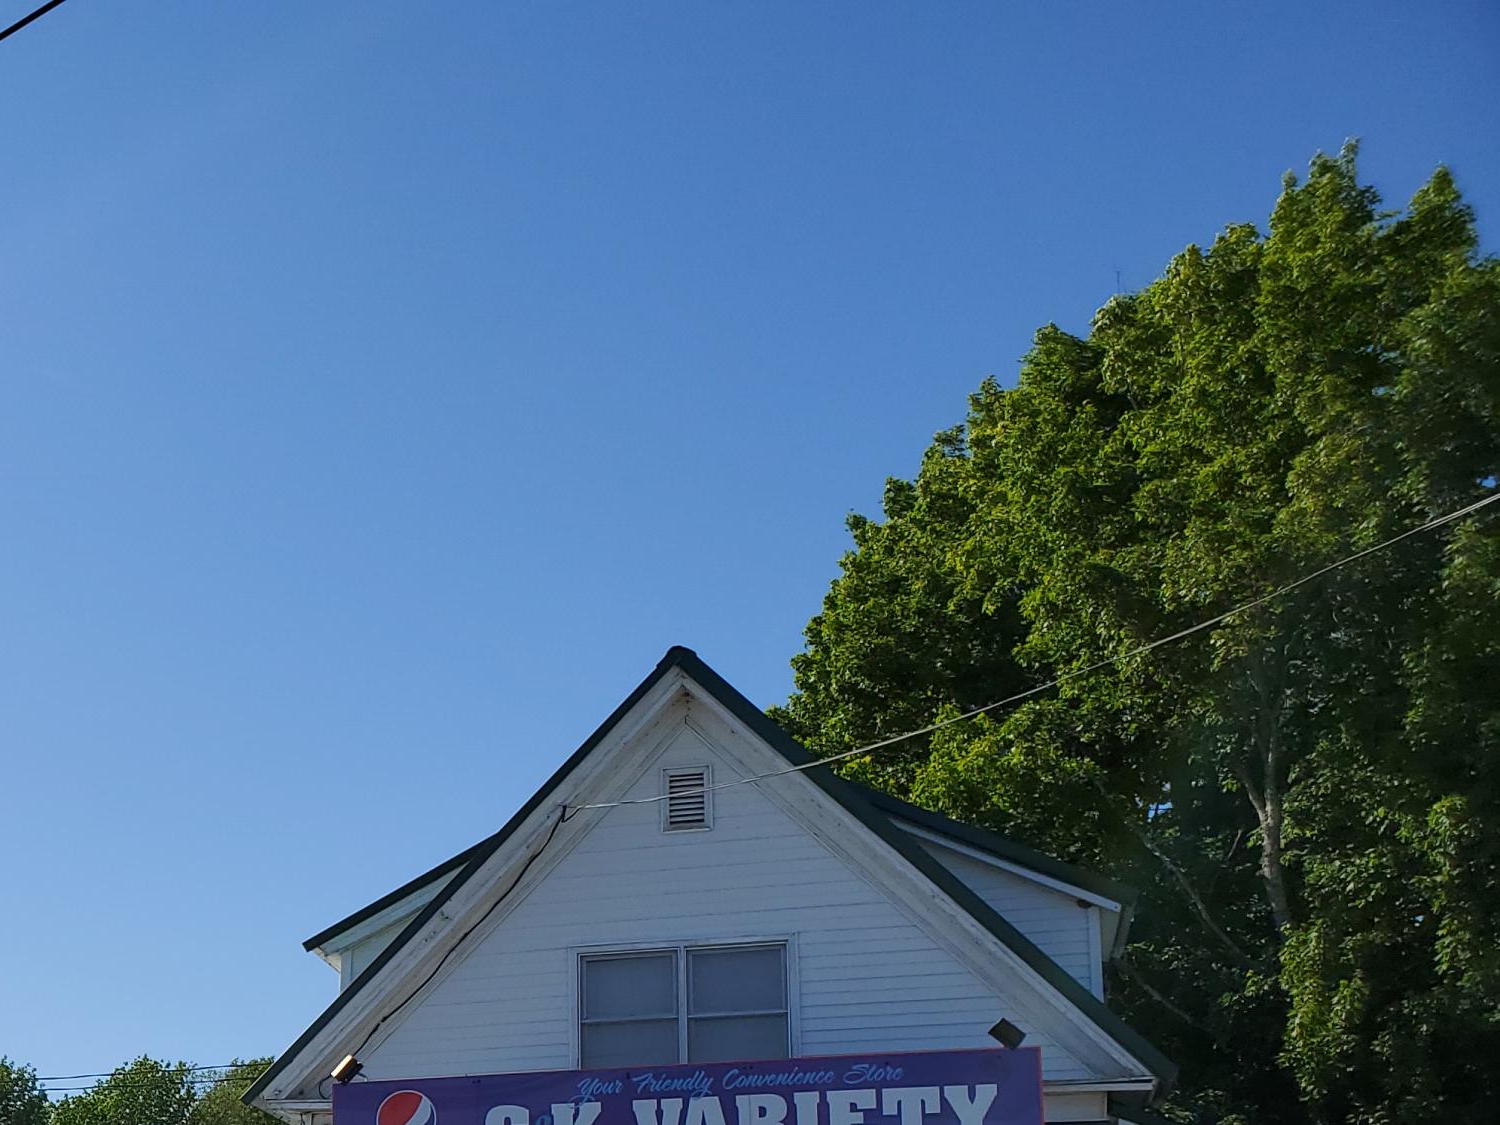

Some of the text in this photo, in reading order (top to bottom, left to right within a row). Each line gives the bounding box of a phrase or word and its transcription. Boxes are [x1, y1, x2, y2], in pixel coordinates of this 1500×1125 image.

[570, 1063, 903, 1107] Your Friendly Convenience Store
